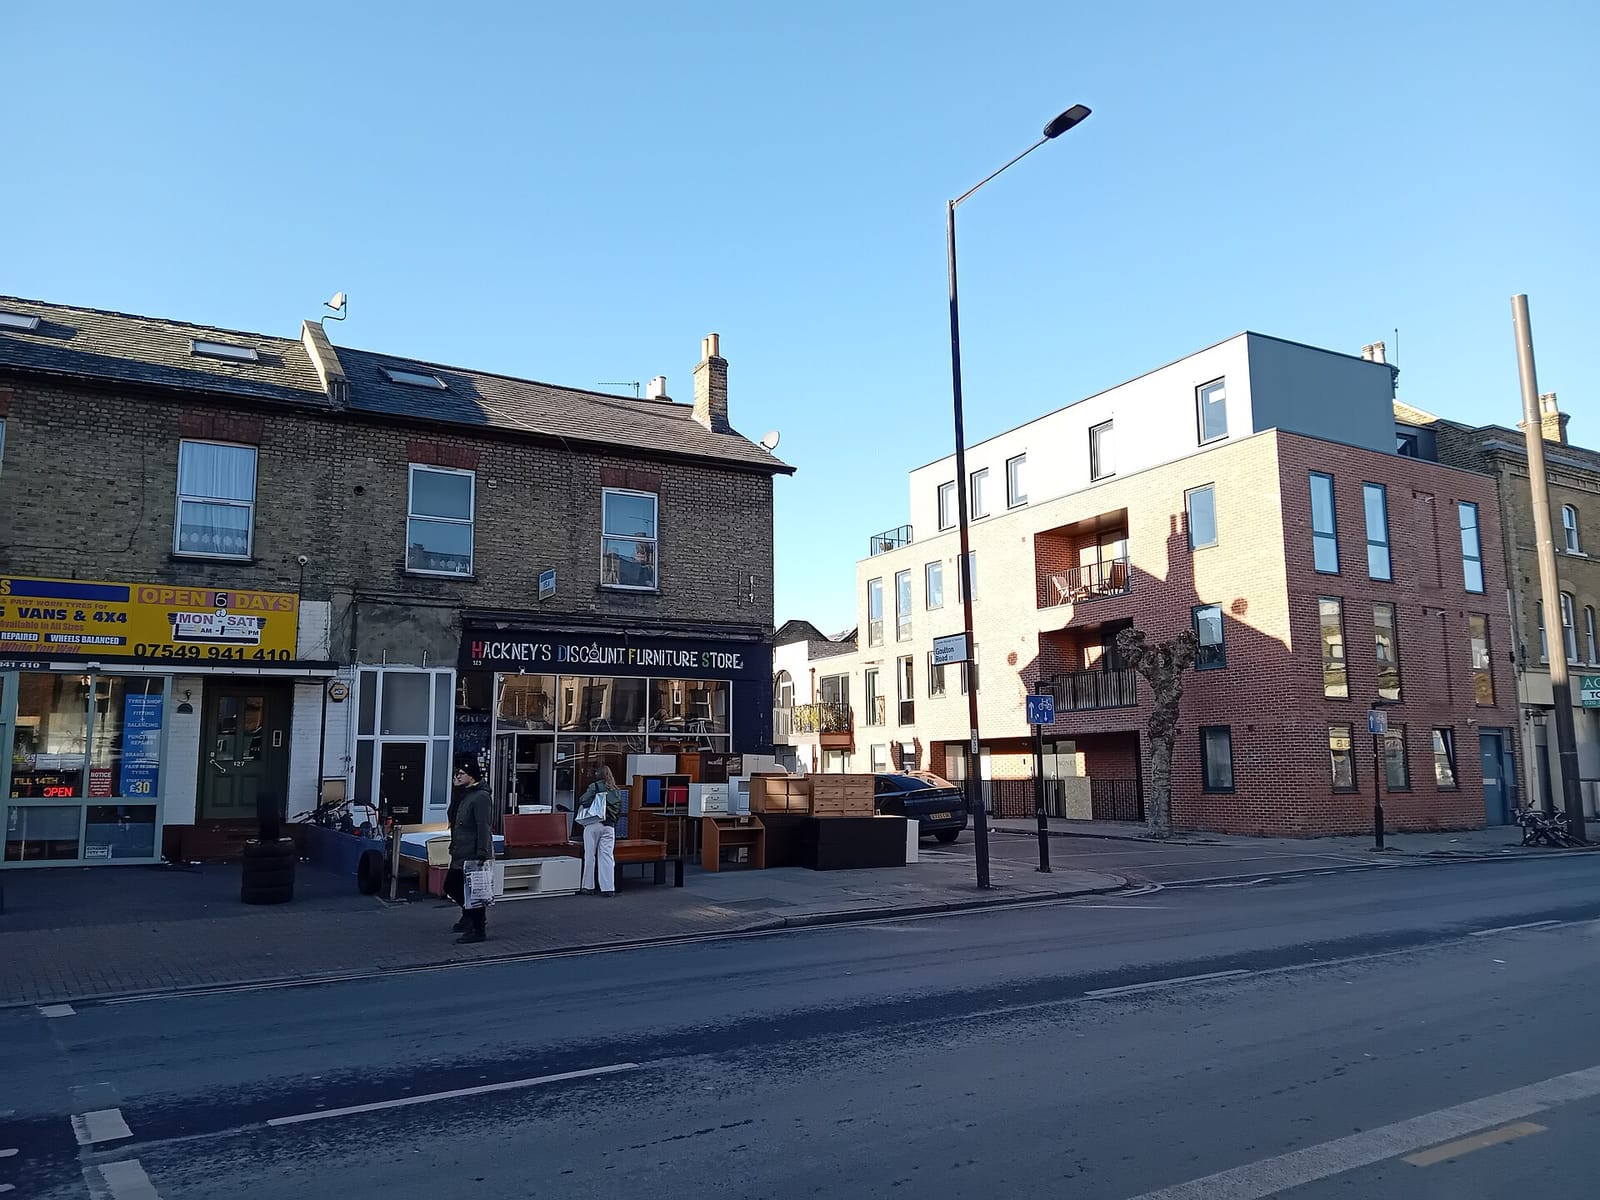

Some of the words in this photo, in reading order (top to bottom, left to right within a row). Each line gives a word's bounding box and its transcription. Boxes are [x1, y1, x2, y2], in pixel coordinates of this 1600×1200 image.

[141, 588, 206, 606] OPEN
[215, 592, 227, 607] 6
[235, 593, 292, 611] DAYS
[18, 607, 67, 620] VANS
[73, 610, 86, 622] &
[93, 611, 127, 623] 4X4
[179, 613, 214, 625] MON
[227, 616, 256, 627] SAT
[1, 632, 38, 641] REPAIRED
[50, 634, 80, 643] WHEELS
[81, 635, 120, 645] BALANCED
[134, 643, 200, 659] 07549
[207, 646, 245, 660] 941
[253, 648, 291, 662] 410
[471, 640, 552, 662] HACKNEY'S
[557, 641, 625, 665] DISCOUNT
[628, 646, 698, 668] FURNITURE
[701, 651, 741, 669] STORE
[936, 655, 948, 663] Road
[43, 787, 74, 797] OPEN
[129, 782, 151, 794] £30
